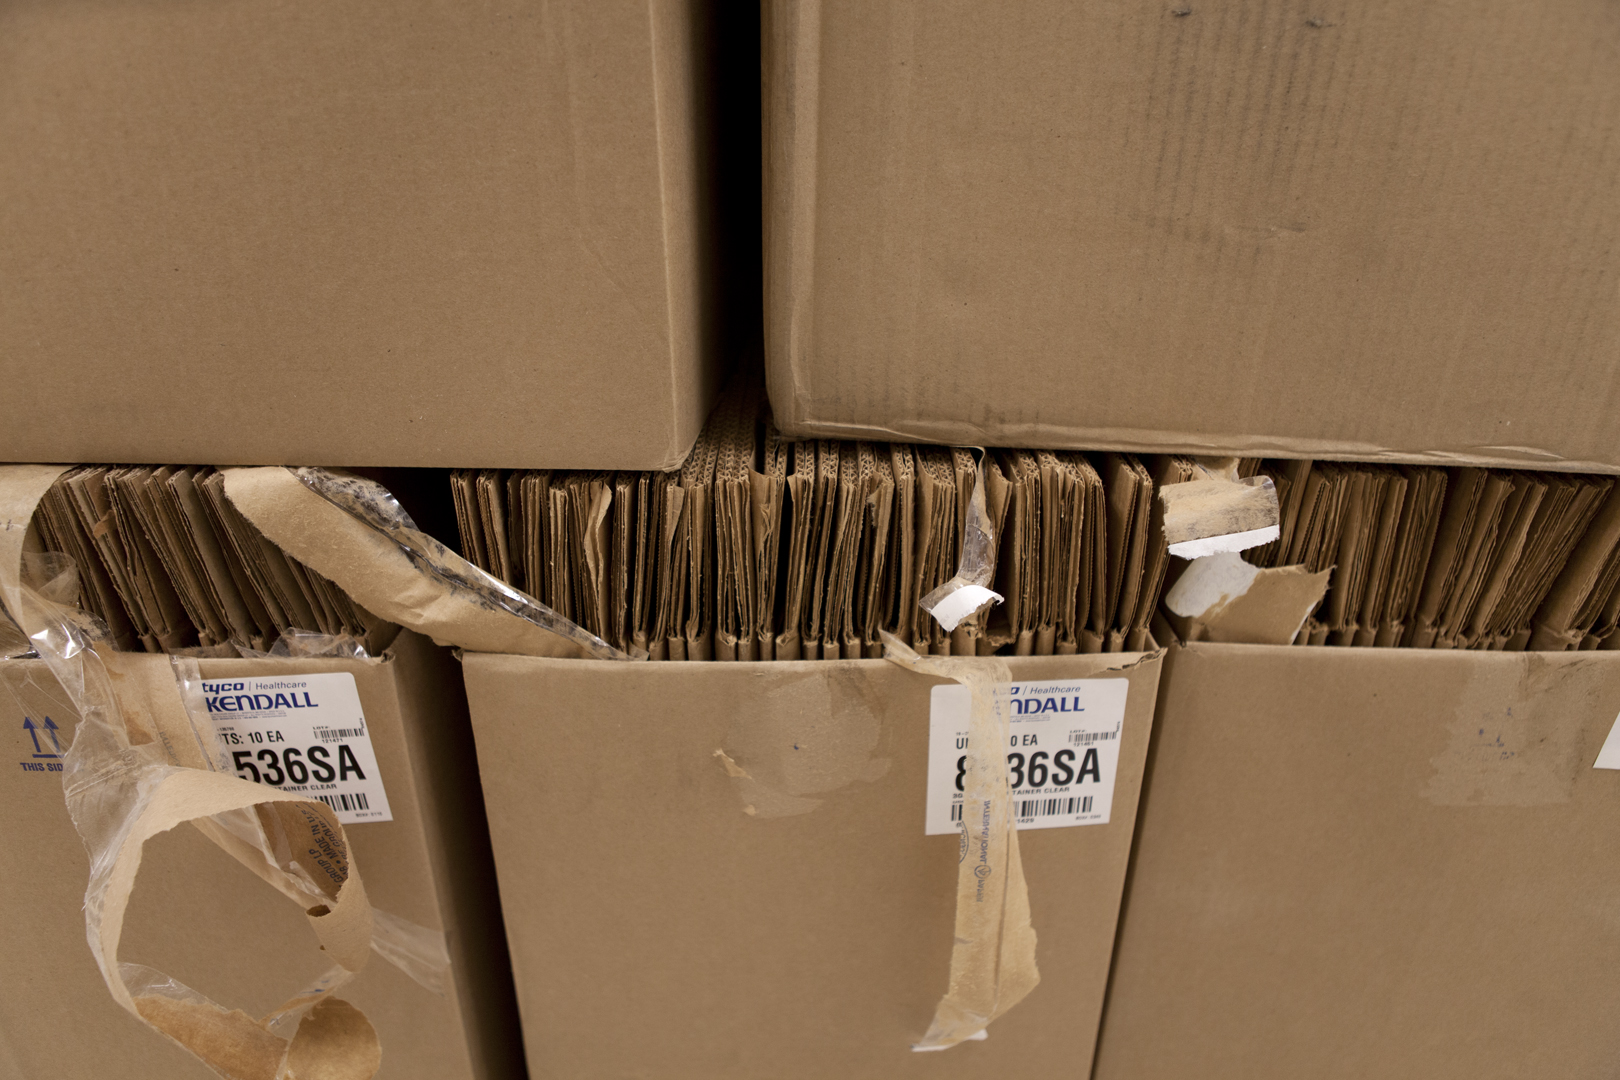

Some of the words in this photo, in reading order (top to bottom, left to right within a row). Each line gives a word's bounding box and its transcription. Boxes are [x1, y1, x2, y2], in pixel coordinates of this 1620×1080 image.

[202, 682, 244, 695] tyco
[256, 681, 306, 690] Healthcare
[1030, 686, 1081, 694] Healthcare
[1010, 696, 1085, 714] NDALL
[220, 732, 244, 744] TS:
[248, 732, 263, 744] 10
[266, 730, 284, 742] EA
[1010, 736, 1018, 746] 0
[1022, 735, 1038, 746] EA
[20, 762, 45, 771] THIS
[46, 763, 63, 771] SID
[232, 744, 366, 786] 536SA
[955, 748, 1100, 792] 836SA
[310, 824, 320, 835] IN
[308, 849, 322, 859] LP
[314, 836, 336, 859] MADE
[318, 860, 344, 883] GROUP
